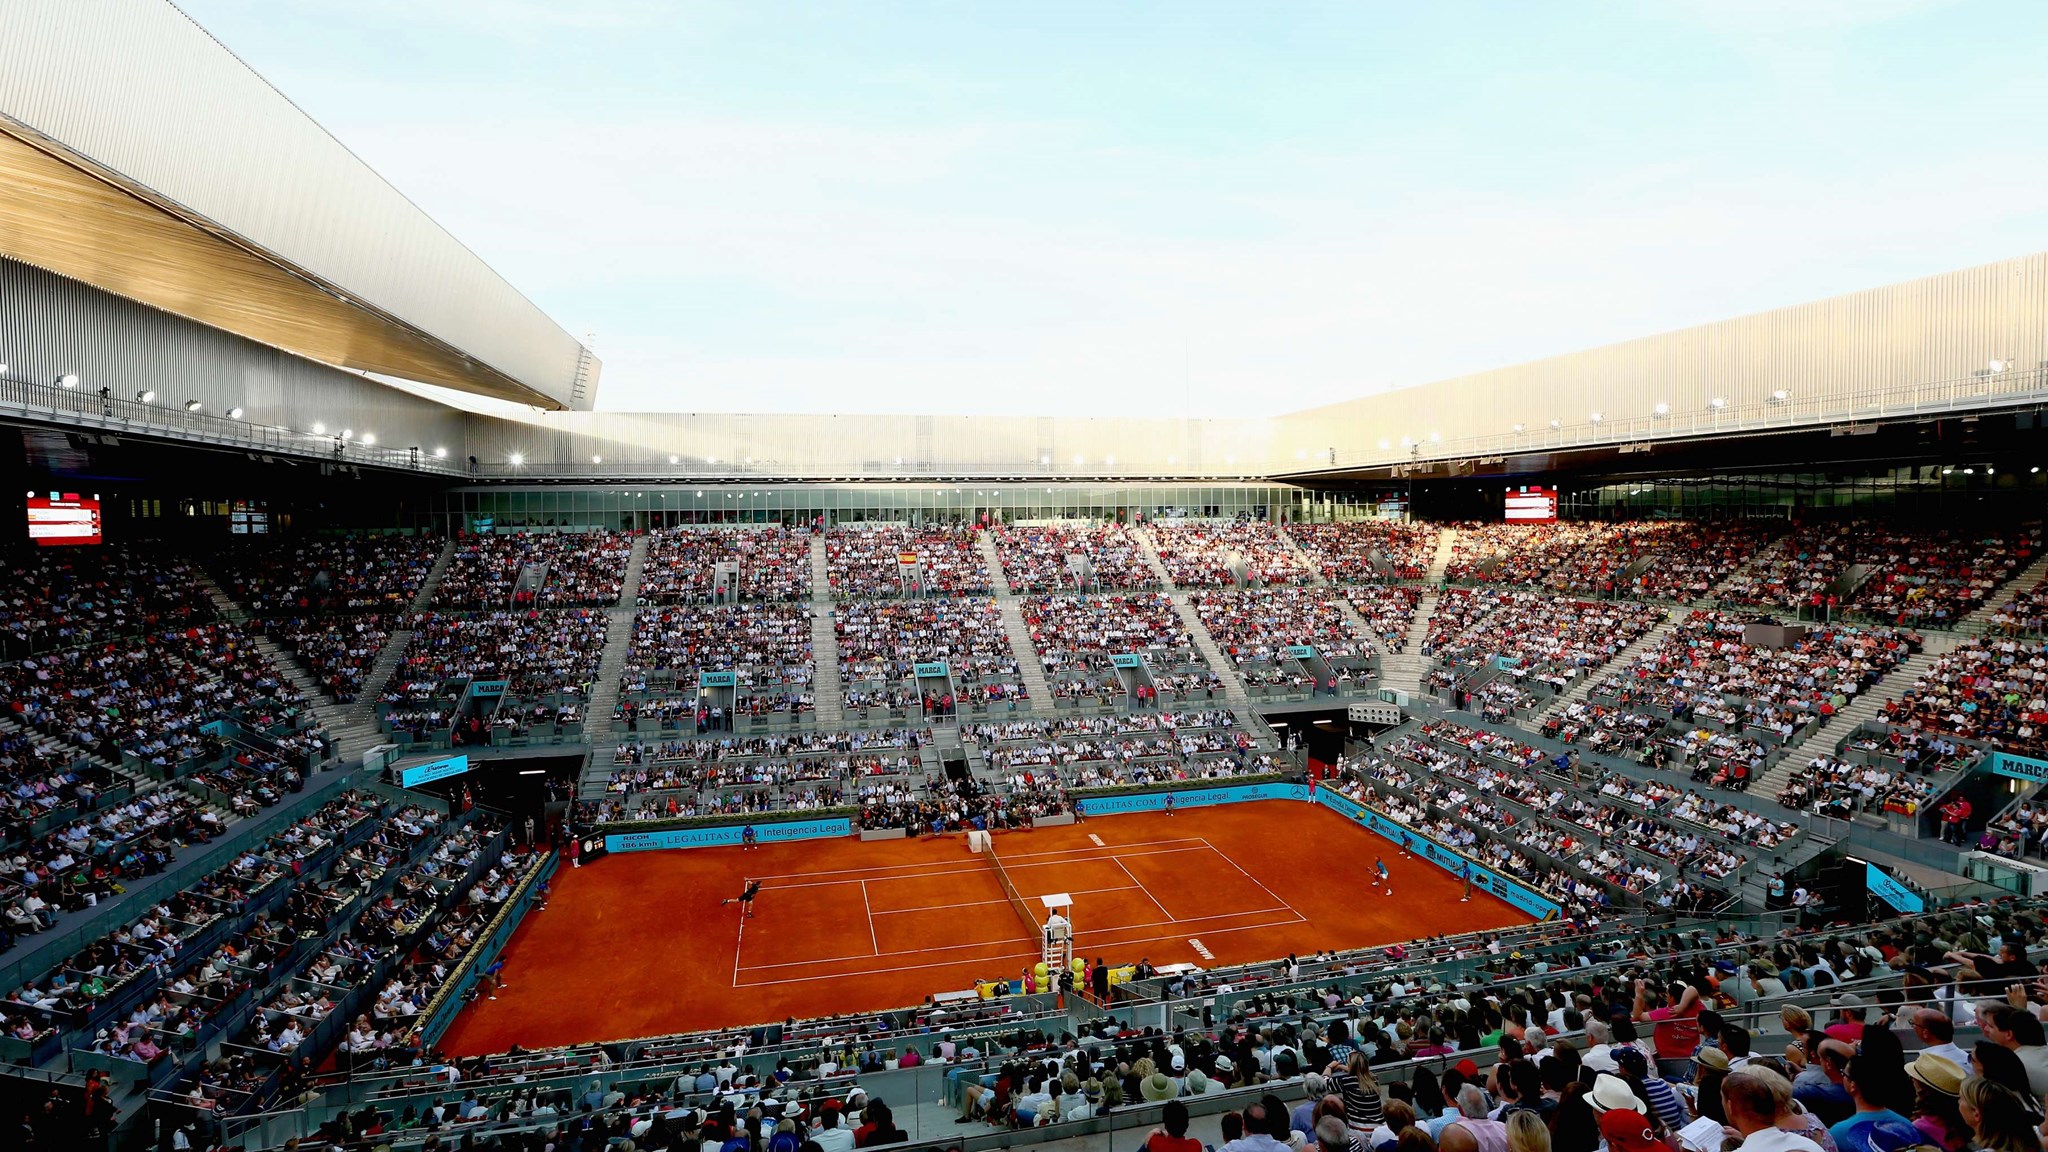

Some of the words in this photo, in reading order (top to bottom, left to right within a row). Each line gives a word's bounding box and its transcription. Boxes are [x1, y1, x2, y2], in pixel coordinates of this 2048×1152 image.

[918, 666, 942, 674] MARCA
[706, 675, 731, 683] MARCA
[478, 685, 505, 693] MARCA
[1085, 798, 1157, 811] EGALITAS.COM
[1161, 795, 1206, 805] Inligencia
[667, 830, 758, 844] LEGALITAS.C
[764, 825, 818, 837] Inteligencia
[820, 822, 848, 834] Legal.
